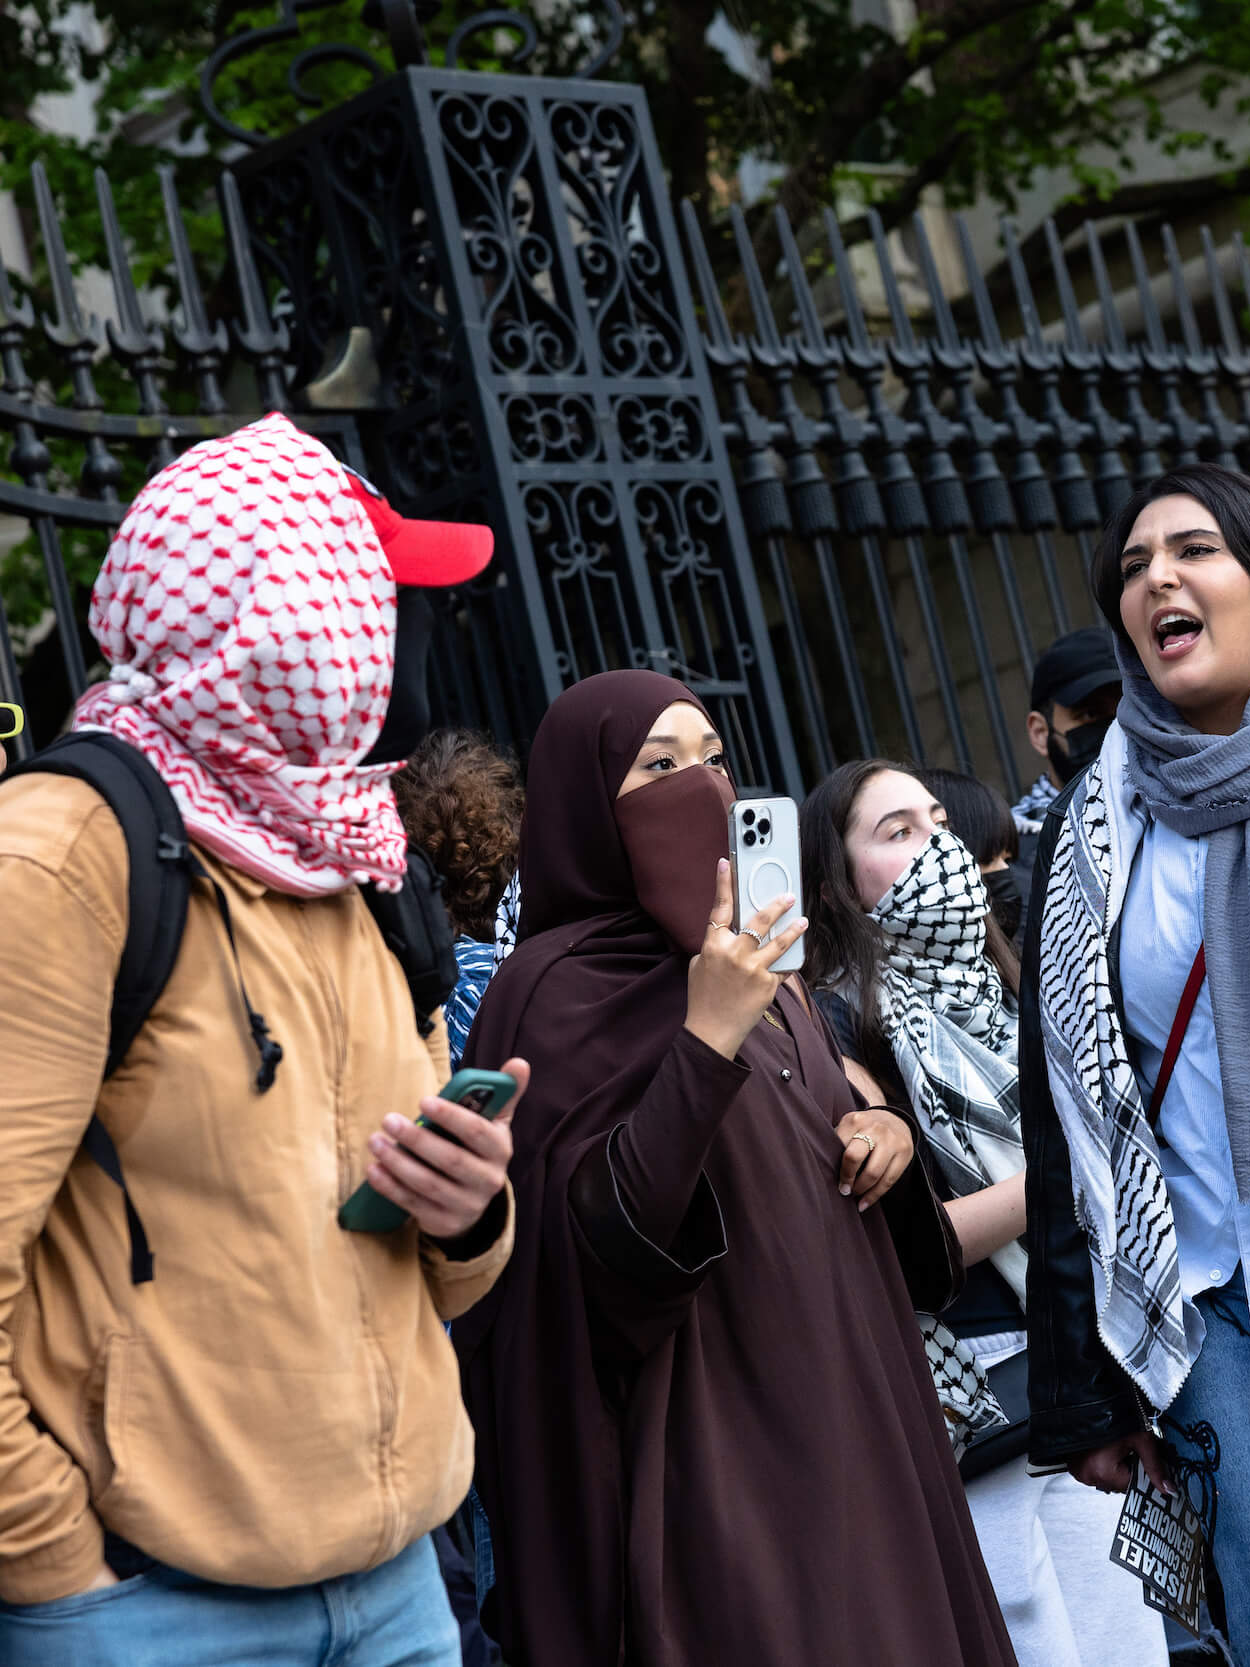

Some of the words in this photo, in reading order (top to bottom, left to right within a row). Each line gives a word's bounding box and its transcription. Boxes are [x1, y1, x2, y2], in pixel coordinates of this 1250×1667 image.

[1125, 1489, 1143, 1518] IN
[1141, 1499, 1194, 1562] GENOCIDE
[1117, 1534, 1185, 1606] ISRAEL
[1120, 1514, 1180, 1571] COMMITTING
